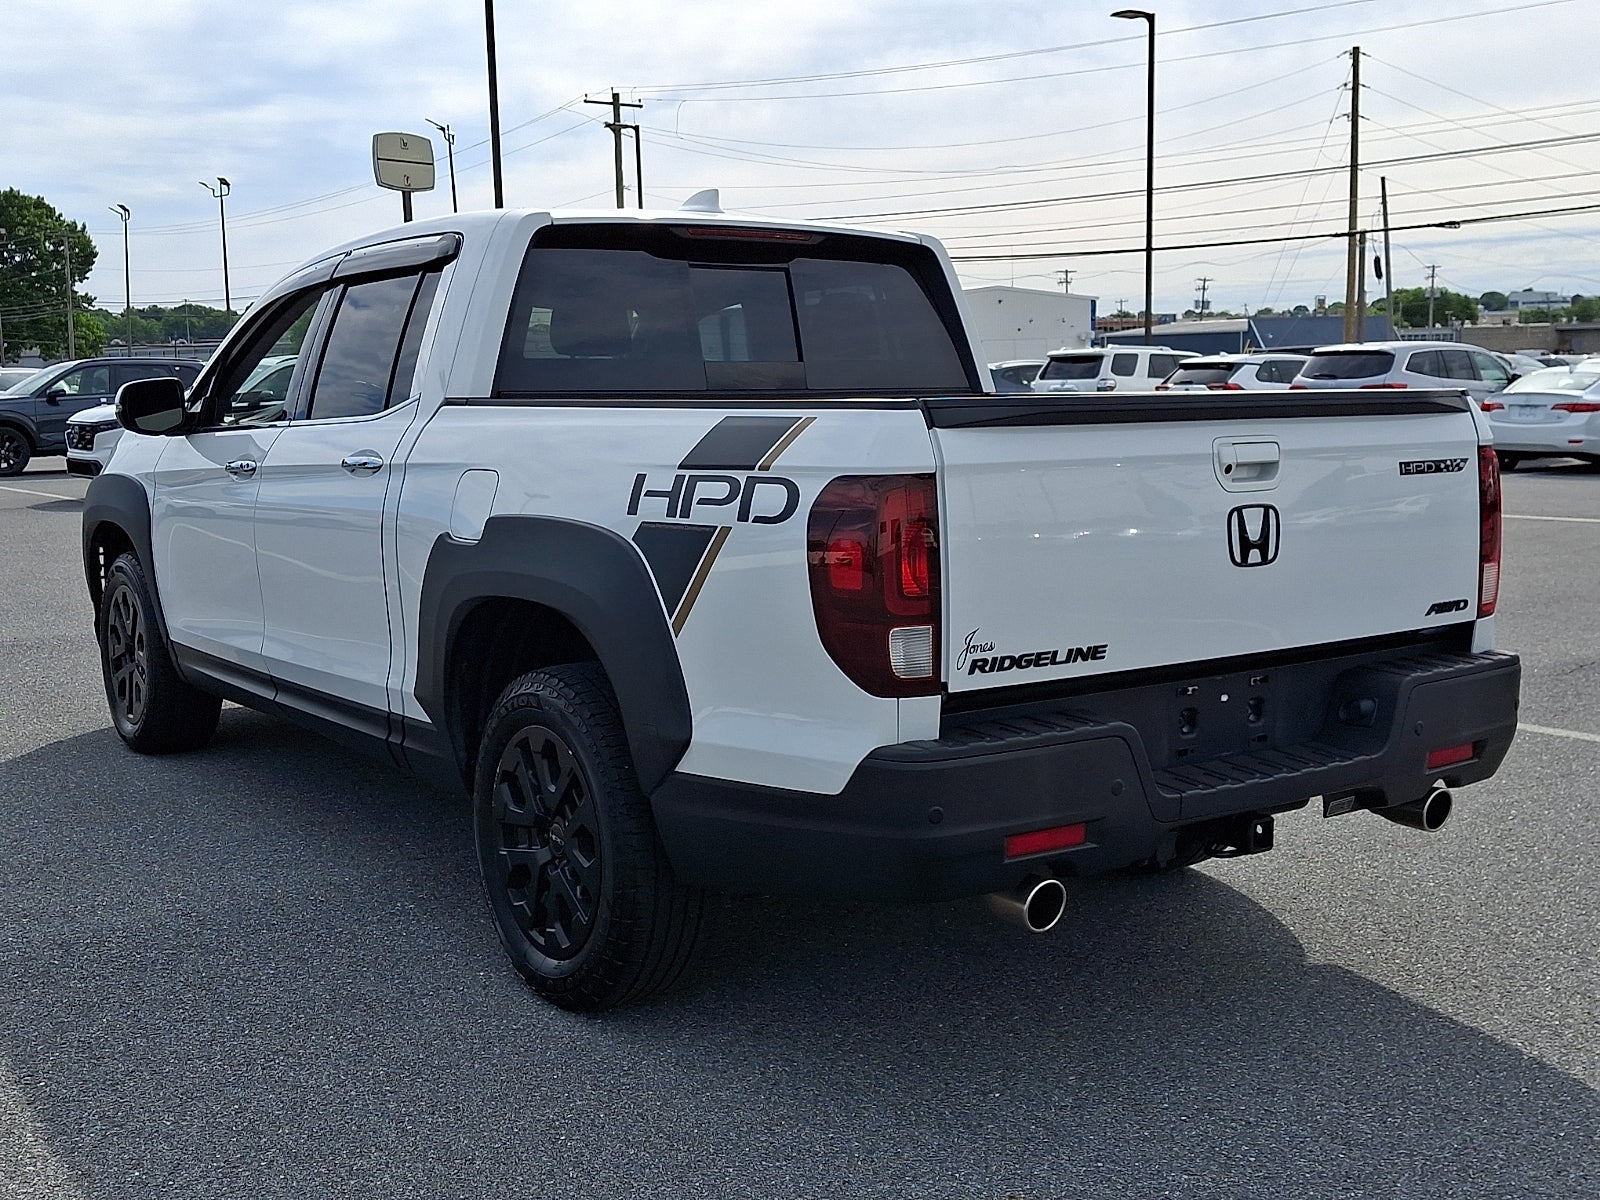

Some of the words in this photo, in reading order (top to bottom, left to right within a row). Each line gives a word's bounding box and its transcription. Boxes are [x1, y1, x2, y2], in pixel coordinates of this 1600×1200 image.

[1402, 462, 1436, 474] HPD
[627, 473, 800, 525] HPD
[1426, 599, 1468, 616] AWD
[956, 627, 996, 671] Jones
[968, 644, 1109, 676] RIDGELINE
